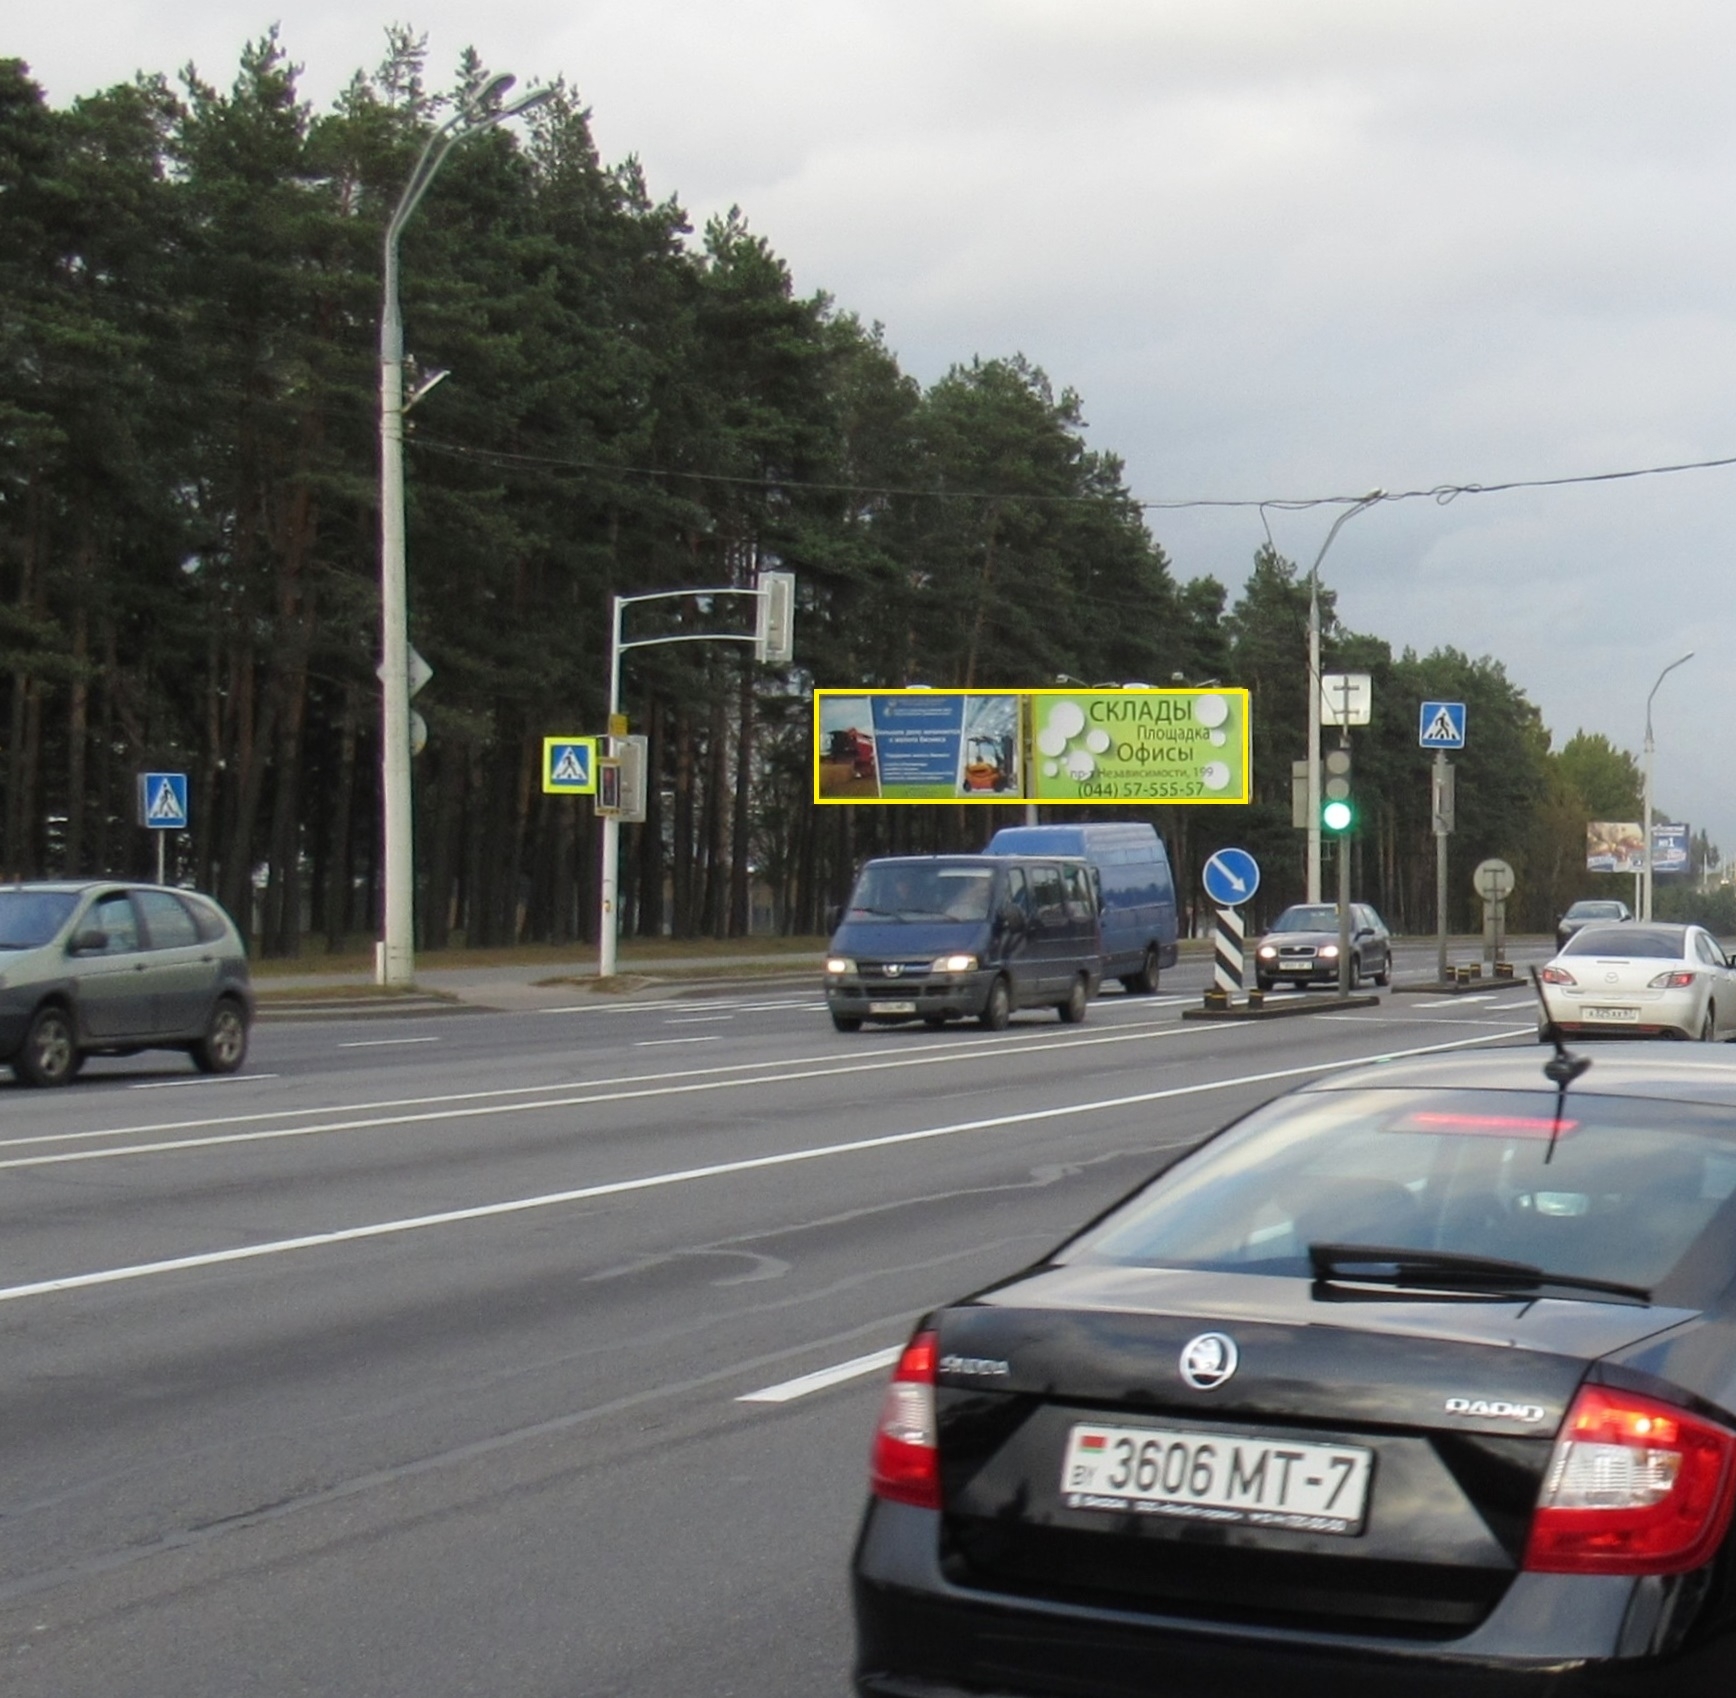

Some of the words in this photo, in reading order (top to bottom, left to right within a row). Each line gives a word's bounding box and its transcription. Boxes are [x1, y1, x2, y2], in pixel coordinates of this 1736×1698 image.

[1089, 700, 1192, 725] СКЛАДЫ
[1137, 725, 1210, 743] Площадка
[1117, 742, 1193, 767] Офисы
[1193, 766, 1214, 778] 199
[1078, 782, 1119, 799] (044)
[1123, 781, 1205, 798] 57-555-57
[1445, 1397, 1545, 1422] RAPID
[1071, 1465, 1098, 1487] BY
[1108, 1436, 1217, 1497] 3606
[1225, 1446, 1356, 1512] MT-7
